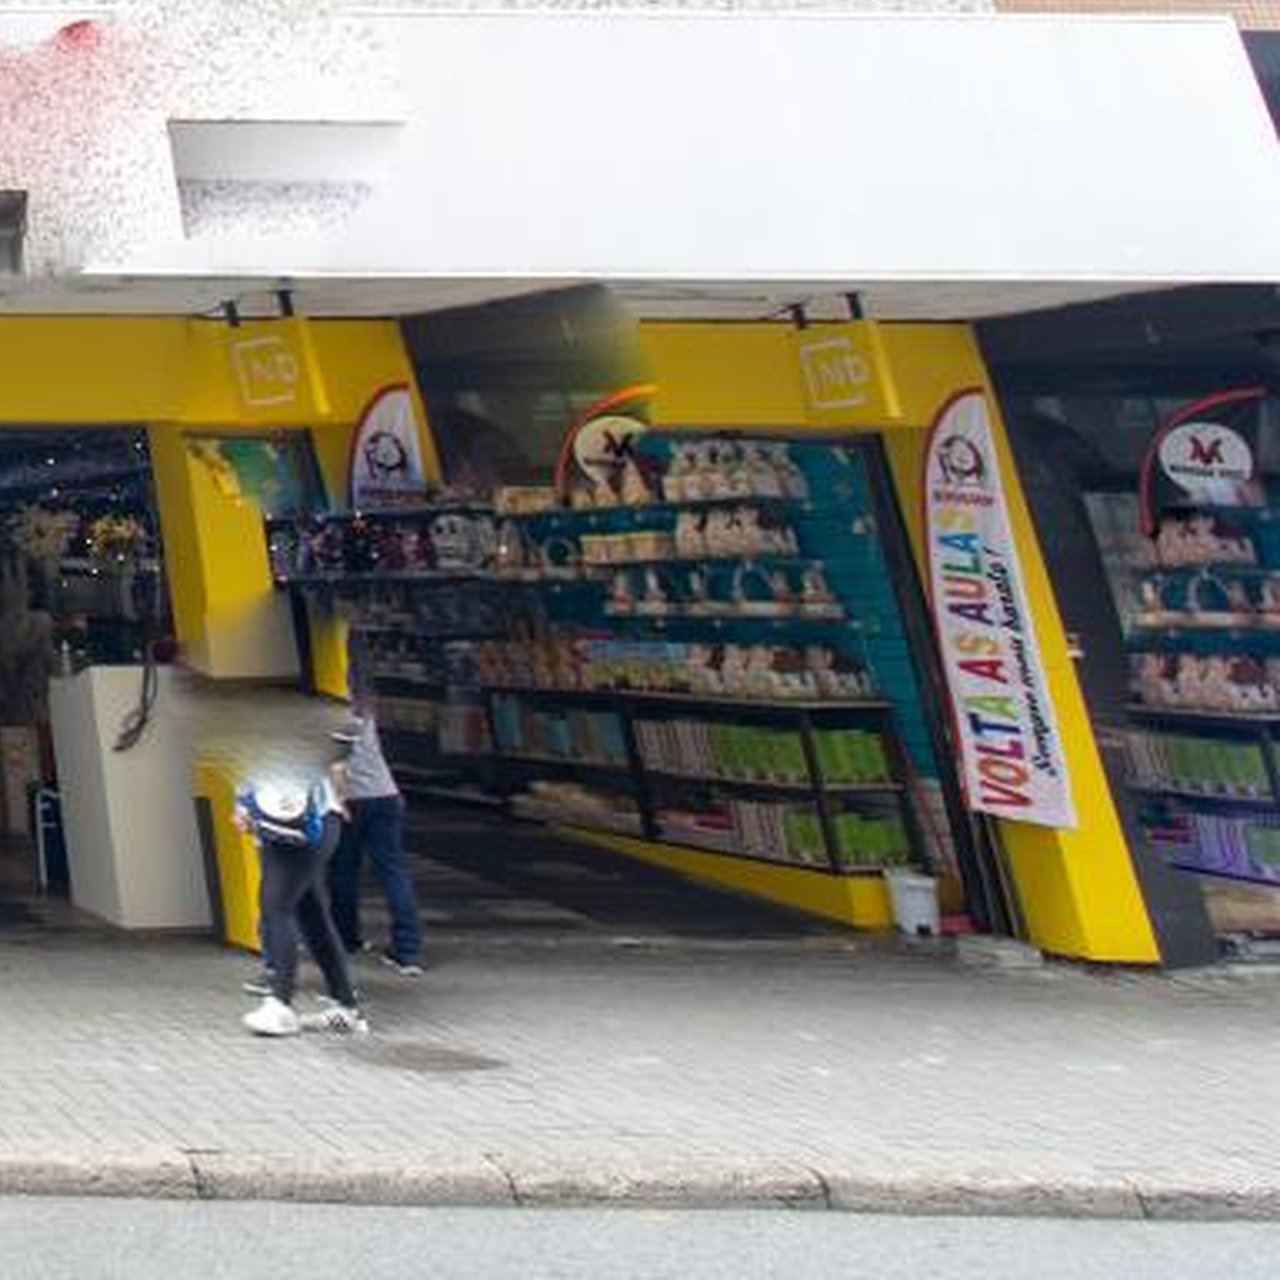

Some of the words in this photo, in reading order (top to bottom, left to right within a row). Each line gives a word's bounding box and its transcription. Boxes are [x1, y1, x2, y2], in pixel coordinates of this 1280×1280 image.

[938, 510, 994, 626] AULAS
[956, 635, 1008, 685] AS
[962, 694, 1033, 808] VOLTA
